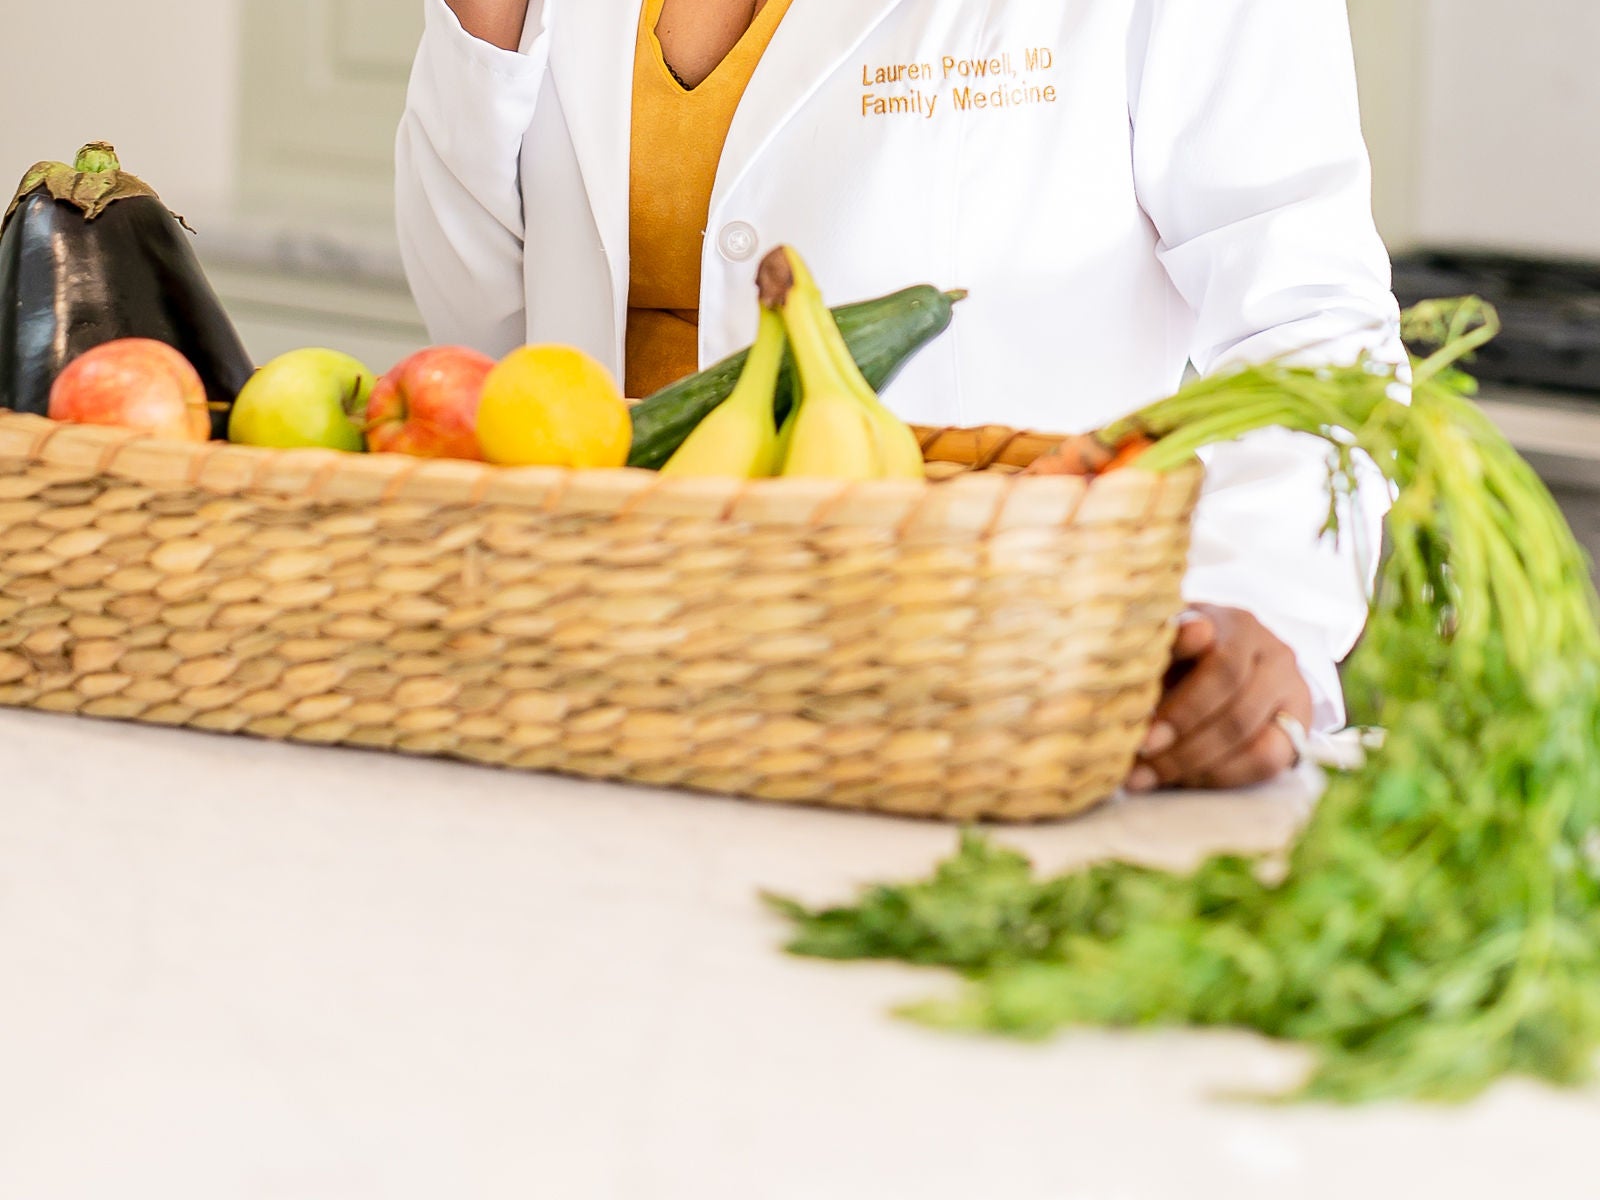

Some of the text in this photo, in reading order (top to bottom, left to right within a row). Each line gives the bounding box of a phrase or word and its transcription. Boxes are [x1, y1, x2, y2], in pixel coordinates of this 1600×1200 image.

[861, 47, 1053, 87] Lauren Powell, MD
[861, 81, 1057, 119] Family Medicine
